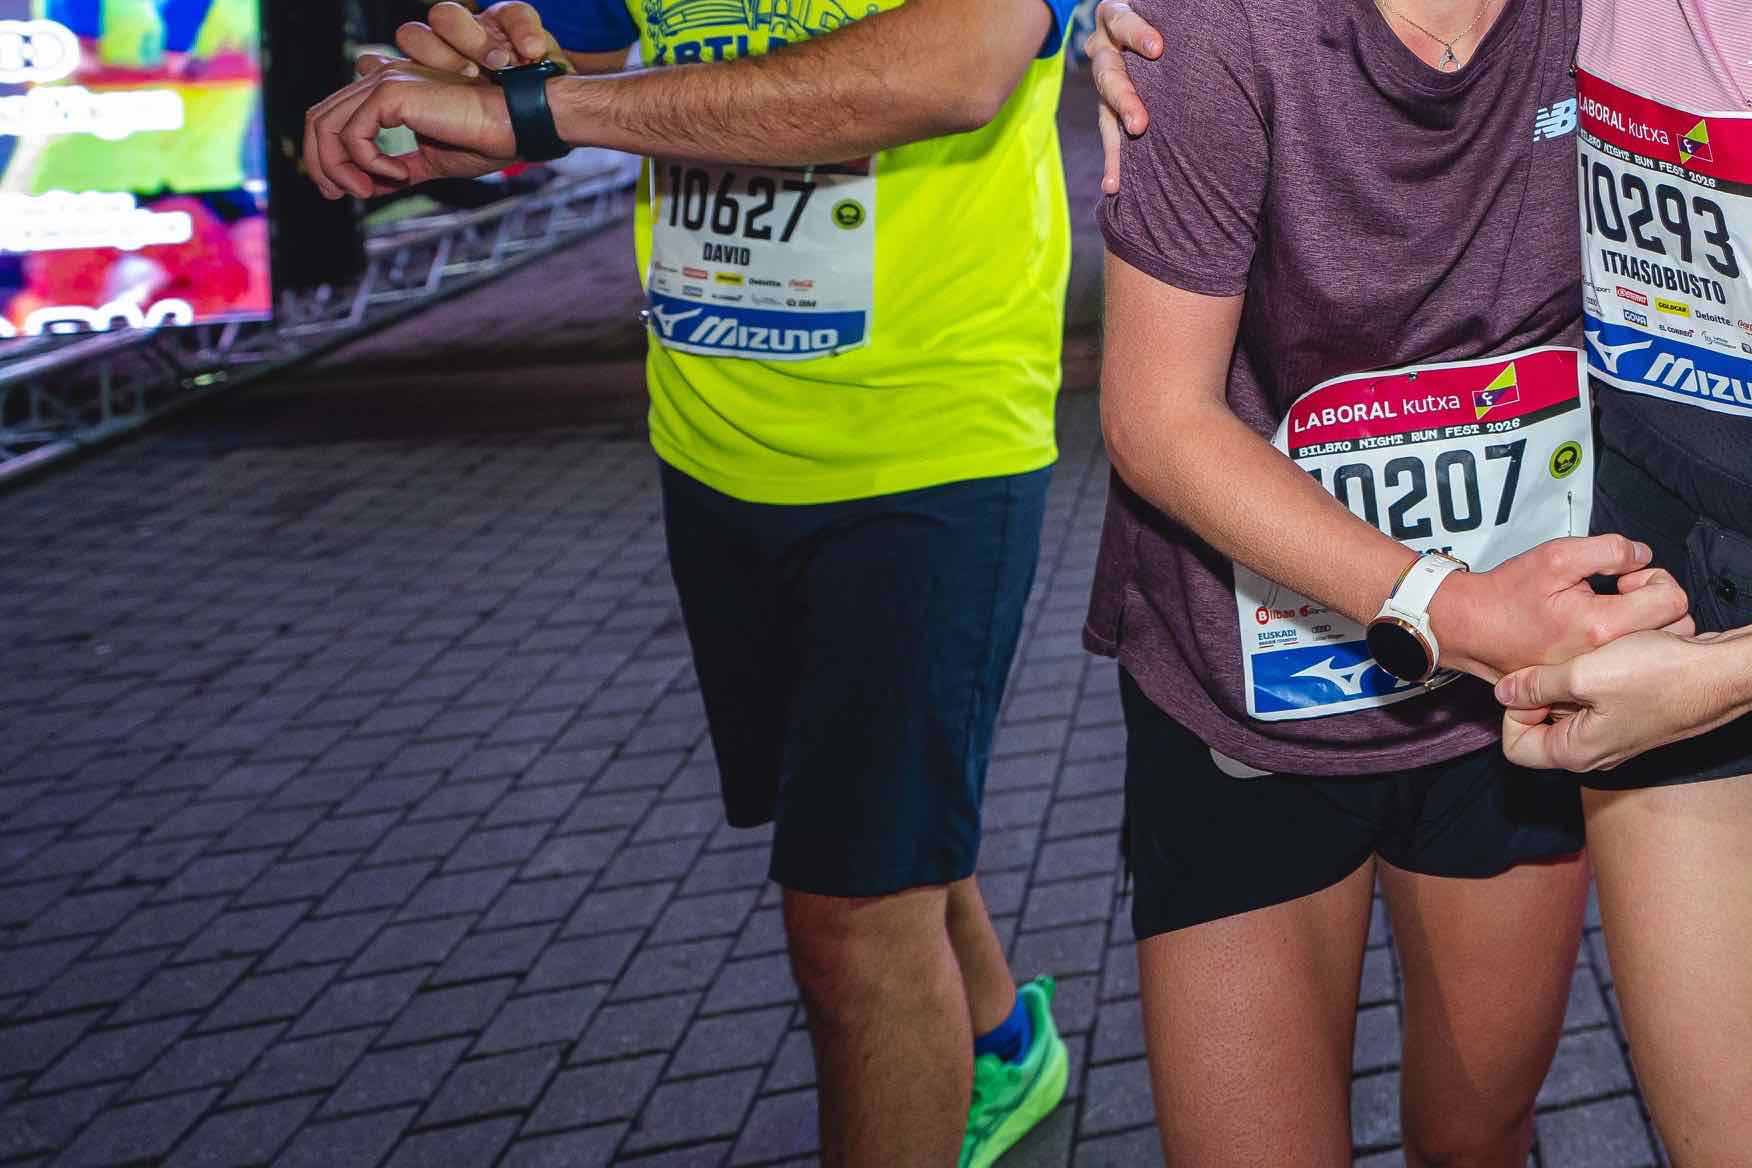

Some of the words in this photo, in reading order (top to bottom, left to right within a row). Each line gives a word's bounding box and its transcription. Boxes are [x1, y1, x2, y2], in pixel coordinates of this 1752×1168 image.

[1578, 90, 1626, 132] LABORAL
[1628, 116, 1670, 145] kutxa
[1603, 142, 1631, 163] NIGHT
[1634, 154, 1655, 169] RUN
[1658, 160, 1686, 178] FEST
[668, 165, 817, 243] 10627
[1579, 152, 1741, 280] 10293
[702, 242, 751, 267] DAVID
[1601, 248, 1728, 306] ITXASOBUSTO
[1293, 400, 1398, 434] LABORAL
[1402, 391, 1461, 416] kutxa
[1298, 438, 1352, 458] BILBAO
[1359, 434, 1404, 450] NIGHT
[1411, 429, 1438, 443] RUN
[1445, 424, 1481, 438] FEST
[1486, 417, 1522, 434] 2026
[1306, 437, 1528, 543] 0207
[1257, 628, 1297, 641] EUSKADI
